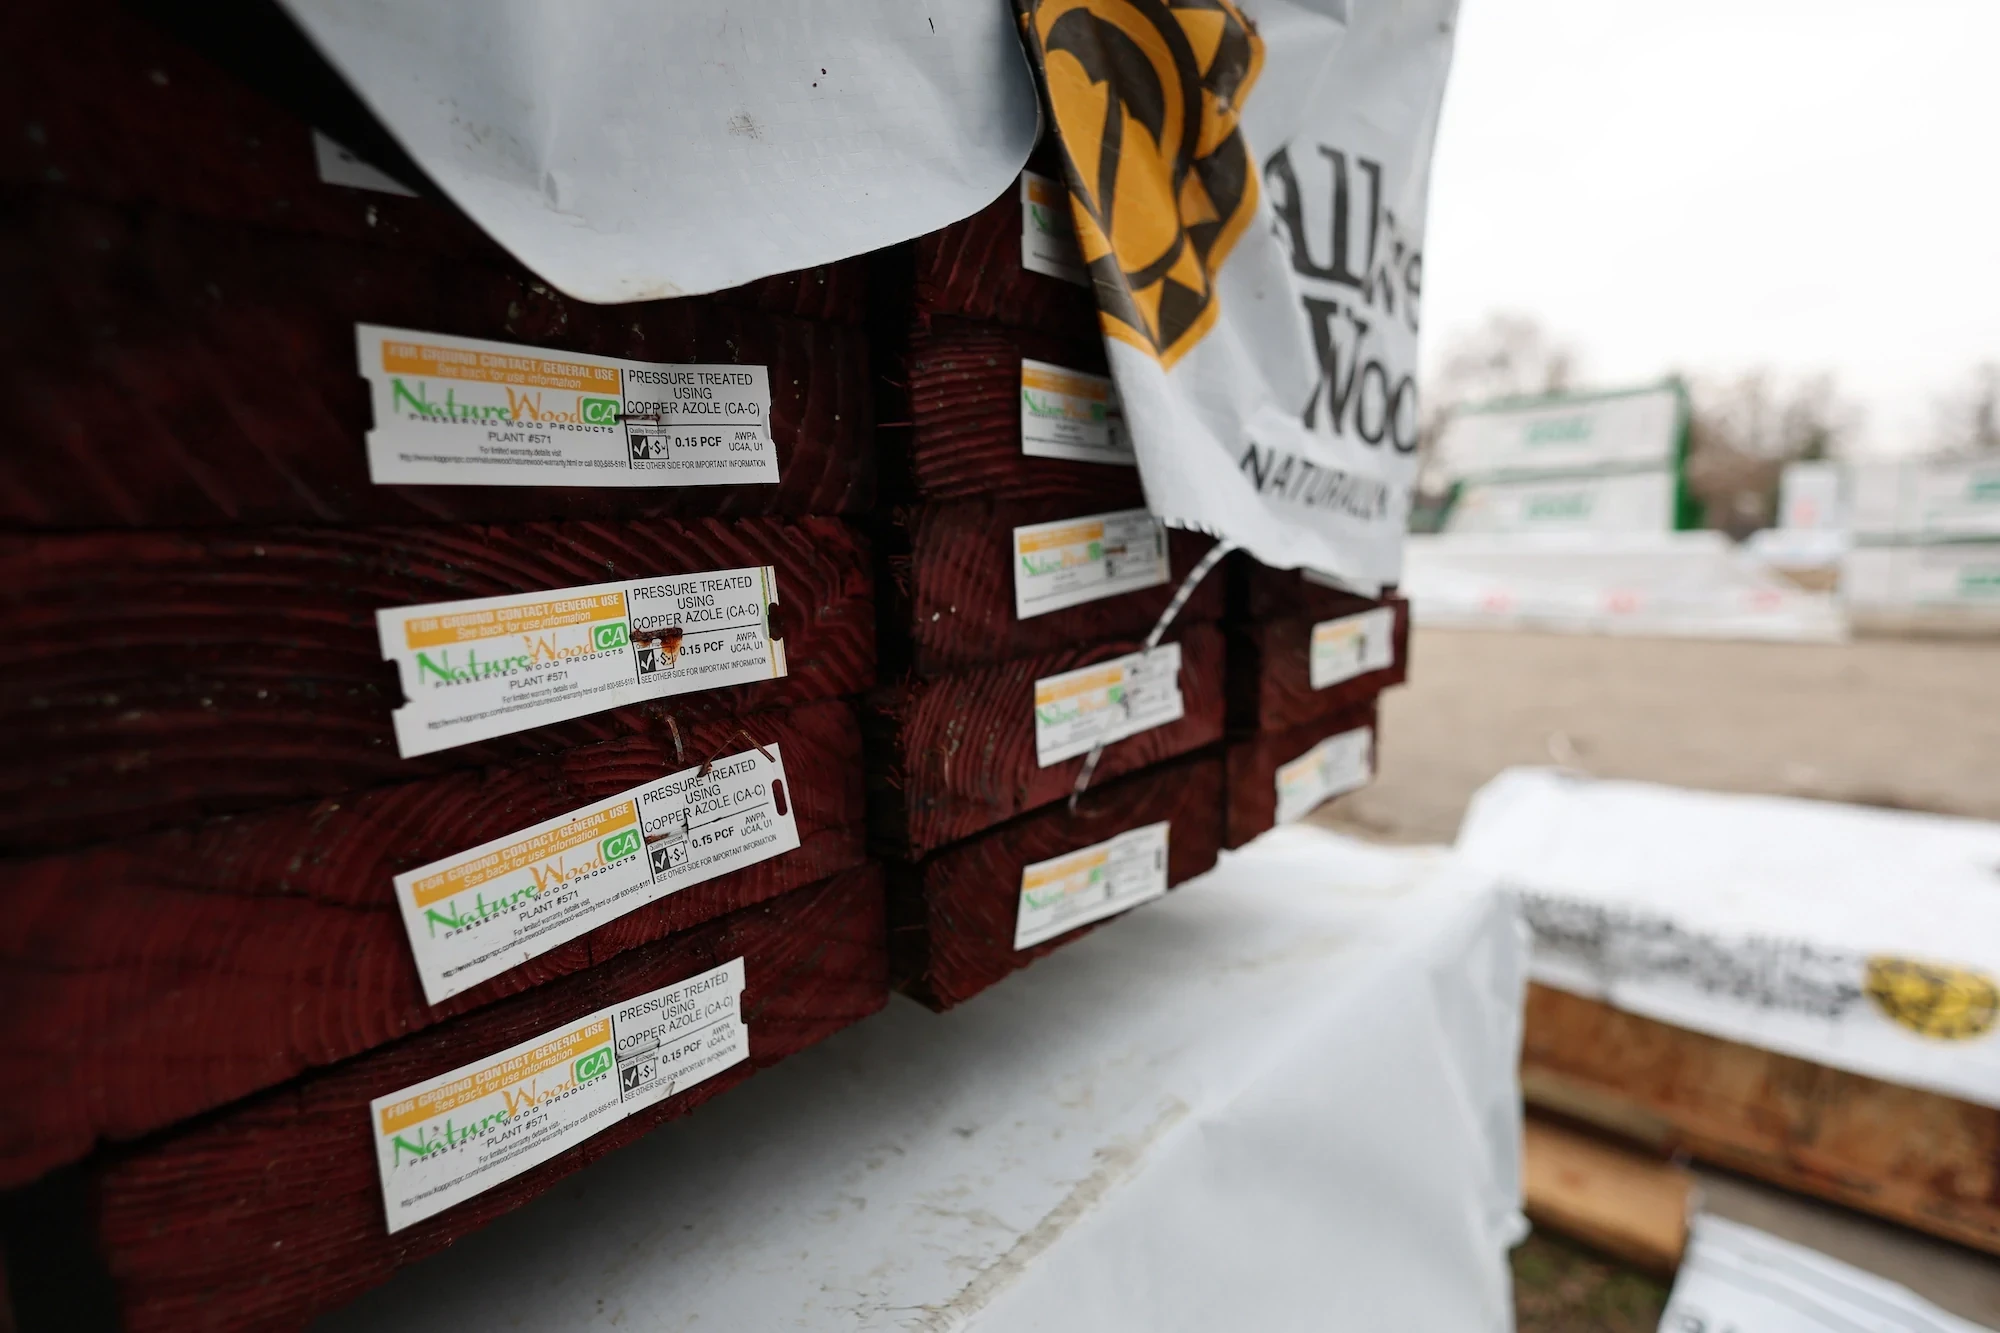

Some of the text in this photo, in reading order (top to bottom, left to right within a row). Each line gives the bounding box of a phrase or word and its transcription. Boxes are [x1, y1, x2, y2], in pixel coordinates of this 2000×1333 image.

[629, 371, 753, 385] PRESSURE TREATED
[673, 387, 712, 400] USING
[585, 402, 616, 423] CA
[627, 401, 760, 417] COPPER AZOLE (CA-C)
[487, 431, 551, 444] PLANT #571
[674, 436, 722, 447] 0.15 PCF
[734, 431, 757, 440] AWPA
[753, 442, 763, 451] U1
[632, 459, 766, 470] SEE OTHER SIDE FOR IMPORTANT INFORMATION
[633, 576, 752, 600] PRESSURE TREATED
[677, 594, 714, 610] USING
[632, 603, 759, 632] COPPER AZOLE (CA-C)
[597, 626, 626, 647] CA
[679, 643, 701, 656] 0.15
[703, 640, 724, 652] PCF
[735, 631, 757, 642] AWPA
[753, 640, 763, 650] U1
[434, 668, 518, 688] PRESERVED
[523, 660, 560, 672] WOOD
[565, 647, 623, 664] PRODUCTS
[640, 656, 766, 684] SEE OTHER SIDE FOR IMPORTANT INFORMATION
[509, 670, 568, 689] PLANT #571
[643, 759, 756, 804] PRESSURE TREATED
[684, 784, 721, 804] USING
[644, 783, 766, 833] COPPER AZOLE (CA-C)
[745, 811, 766, 825] AWPA
[762, 818, 773, 828] U1
[419, 874, 444, 890] FOR
[447, 854, 499, 880] GROUND
[609, 803, 628, 818] USE
[606, 832, 638, 858] CA
[691, 826, 734, 849] 0.15 PCF
[463, 828, 598, 888] See back for use information
[655, 834, 777, 883] SEE OTHER SIDE FOR IMPORTANT INFORMATION
[445, 854, 636, 939] PRESERVED WOOD PRODUCTS
[518, 890, 578, 921] PLANT #571
[619, 972, 728, 1022] PRESSURE TREATED
[661, 998, 695, 1020] USING
[618, 995, 733, 1051] COPPER AZOLE (CA-C)
[661, 1048, 681, 1064] 0.15
[683, 1039, 701, 1055] PCF
[387, 1100, 415, 1118] FOR
[418, 1077, 472, 1106] GROUND
[584, 1021, 604, 1038] USE
[579, 1051, 609, 1078] CA
[409, 1073, 607, 1167] PRESERVED WOOD PRODUCTS
[486, 1113, 548, 1148] PLANT #571
